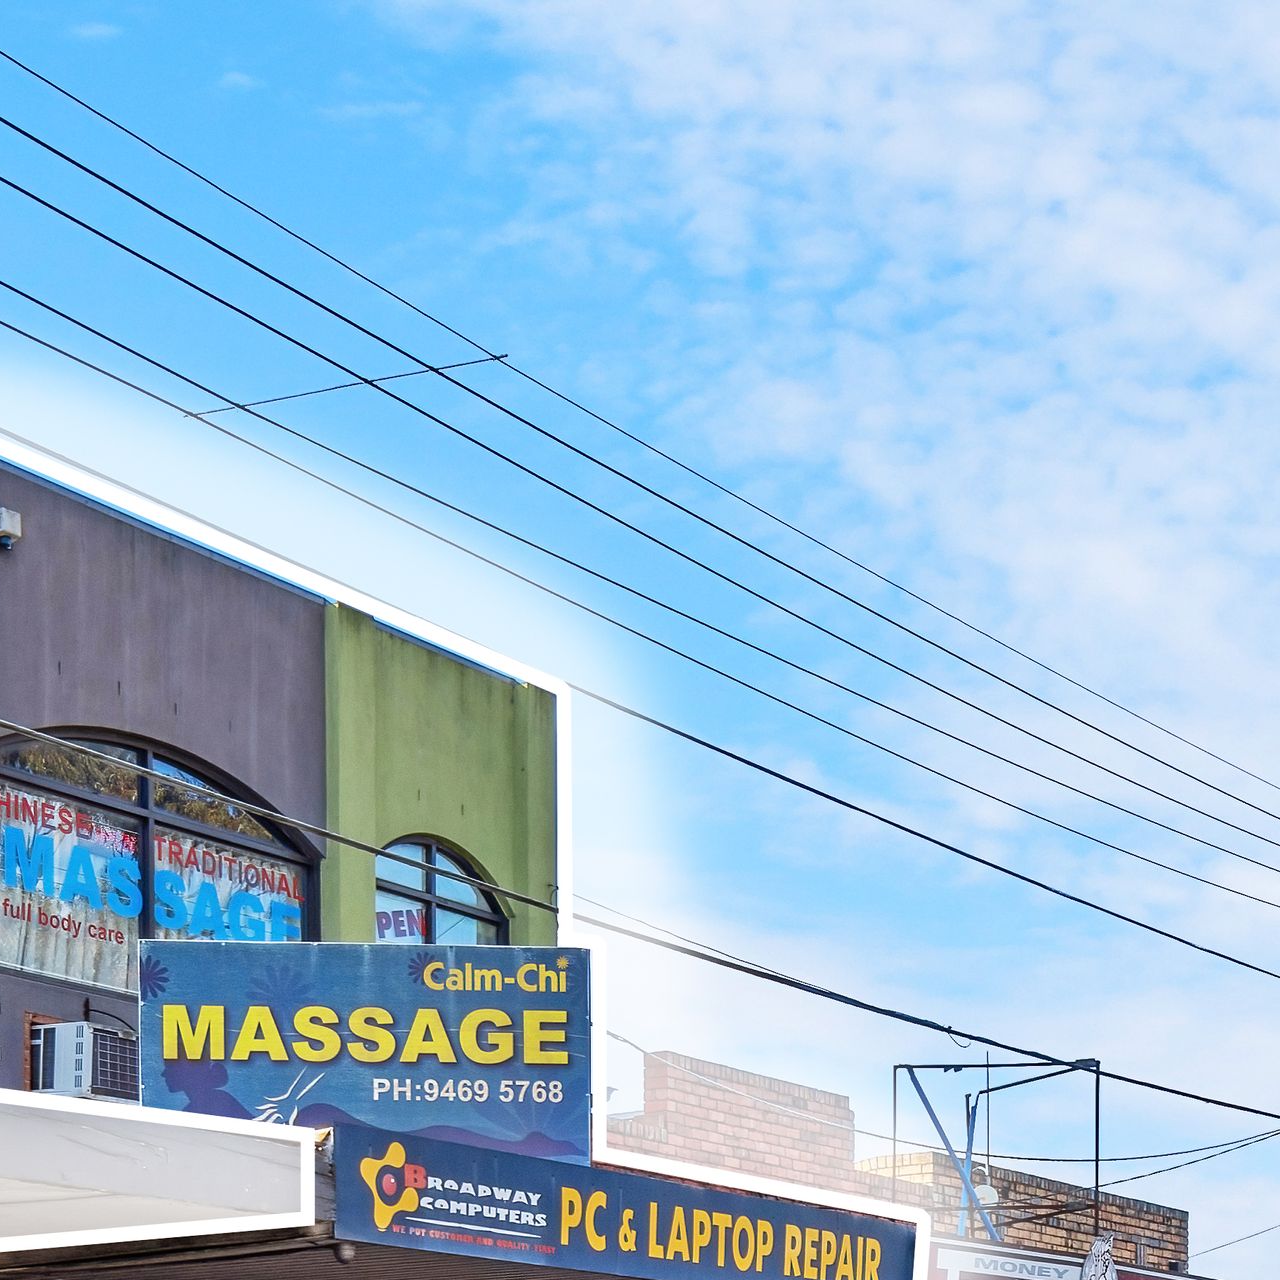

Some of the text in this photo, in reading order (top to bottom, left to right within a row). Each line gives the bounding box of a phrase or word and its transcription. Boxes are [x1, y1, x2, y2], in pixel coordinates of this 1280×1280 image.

[2, 825, 302, 942] MASSAGE
[154, 835, 304, 902] TRADITIONAL
[2, 898, 125, 944] full body care
[376, 909, 427, 938] PEN
[423, 955, 569, 992] Calm-Chi
[162, 1005, 568, 1065] MASSAGE
[499, 1080, 564, 1103] 5768
[404, 1163, 542, 1206] BROADWAY
[420, 1196, 547, 1227] COMPUTERS
[560, 1186, 608, 1252] PC
[618, 1208, 637, 1251] &
[648, 1201, 774, 1272] LAPTOP
[392, 1224, 406, 1234] WE
[410, 1228, 426, 1237] PUT
[430, 1230, 475, 1243] CUSTOMER
[476, 1237, 493, 1246] AND
[497, 1239, 530, 1251] QUALITY
[974, 1257, 1070, 1279] MONEY
